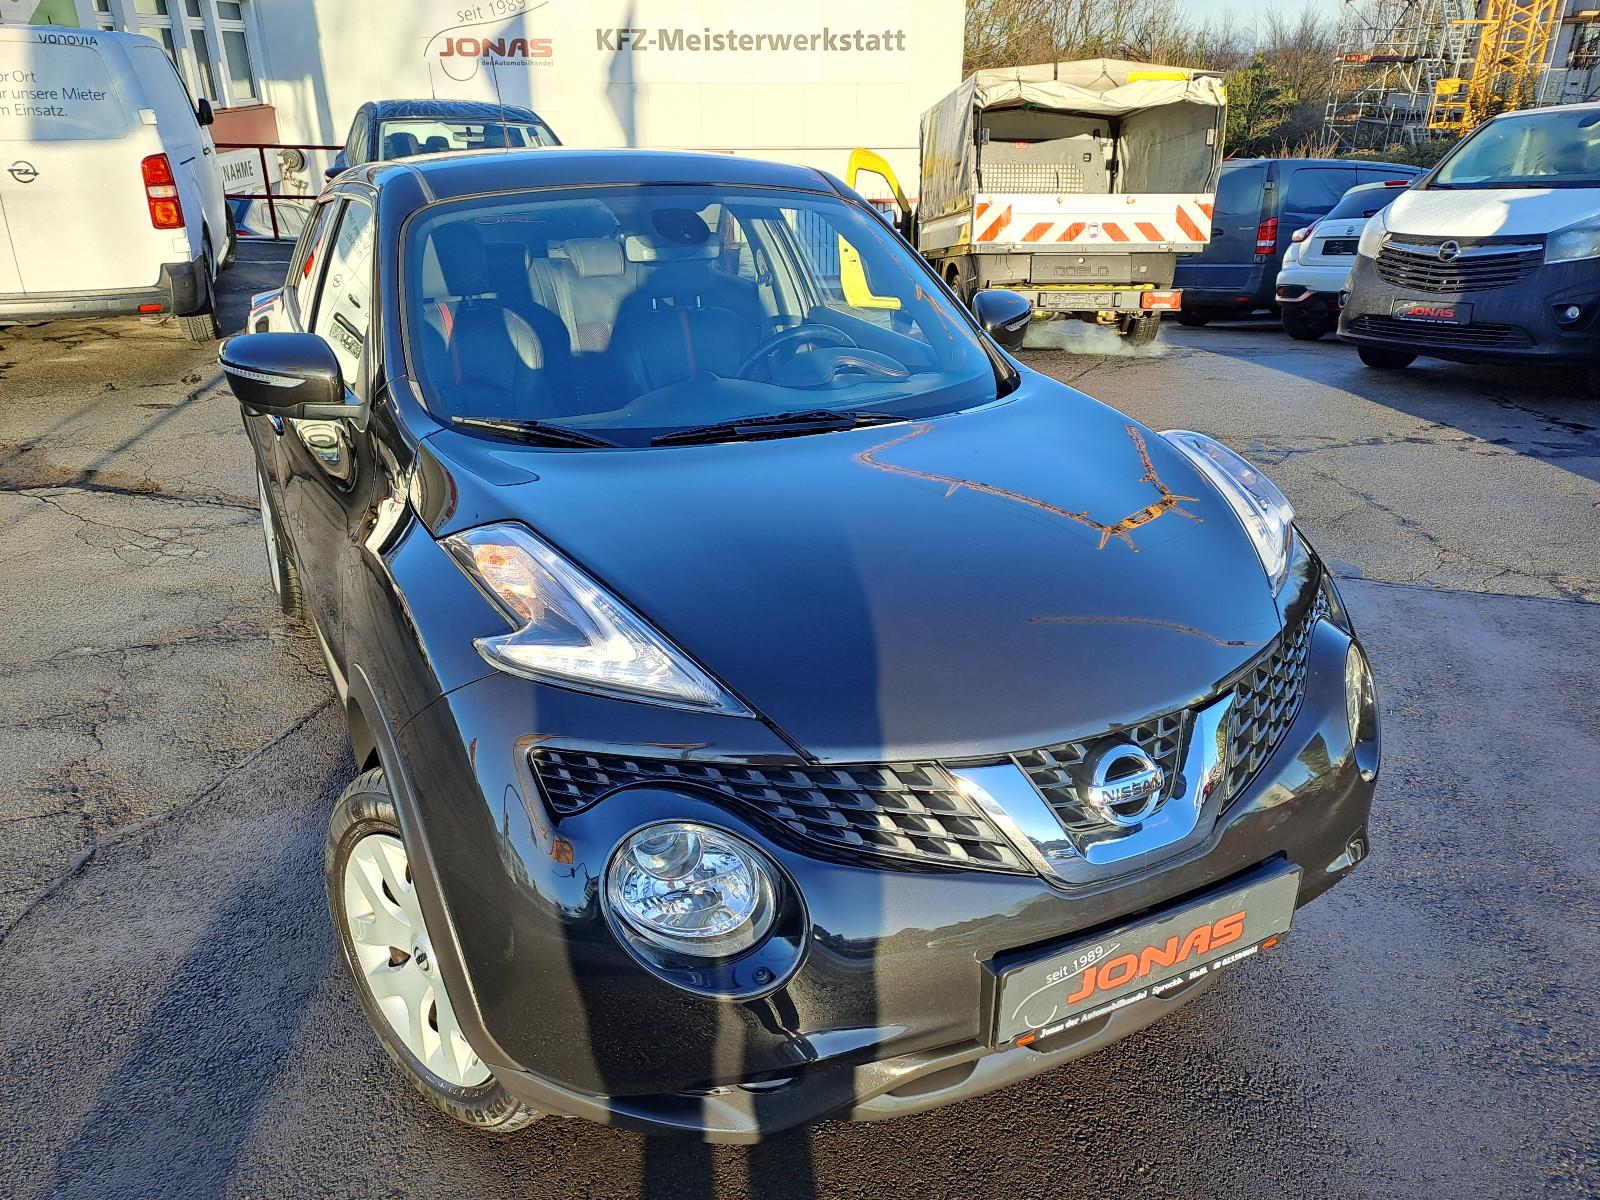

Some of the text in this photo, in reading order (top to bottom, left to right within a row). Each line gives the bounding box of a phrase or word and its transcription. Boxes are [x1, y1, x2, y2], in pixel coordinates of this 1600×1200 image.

[456, 0, 527, 23] seit 1989
[439, 37, 553, 58] JONAS
[596, 27, 906, 52] KFZ-Meisterwerkstatt
[12, 70, 37, 83] Ort
[11, 90, 58, 100] unsere
[62, 87, 107, 101] Mieter
[14, 103, 68, 117] Einsatz.
[220, 160, 254, 182] NAHME
[1408, 306, 1456, 318] JONAS
[1101, 775, 1161, 802] NISSAN
[1045, 945, 1103, 984] seit 1989
[1067, 911, 1246, 1005] JONAS
[1040, 1024, 1064, 1039] Jonas
[1065, 1017, 1080, 1029] der
